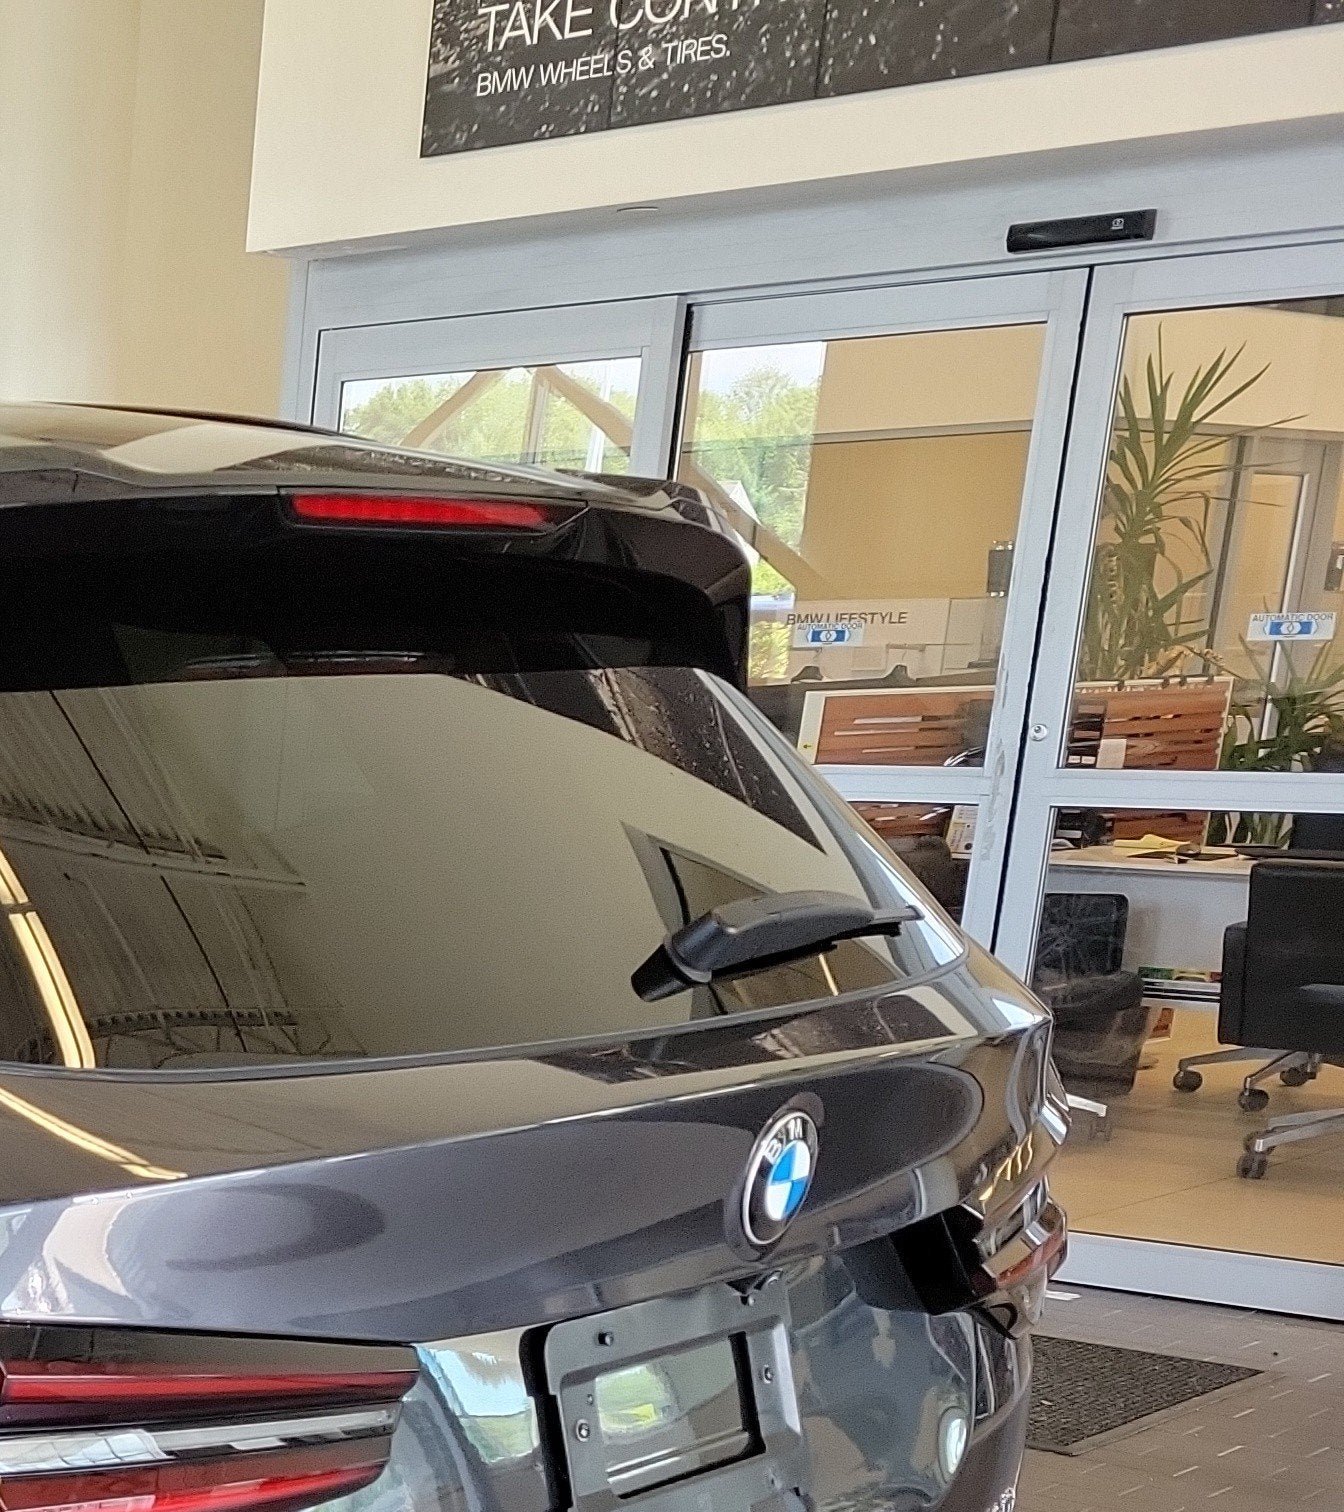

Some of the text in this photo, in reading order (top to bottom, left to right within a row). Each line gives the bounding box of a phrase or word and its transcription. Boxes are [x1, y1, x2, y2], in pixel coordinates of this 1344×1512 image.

[477, 0, 593, 53] TAKE
[476, 33, 731, 97] BMW WHEELS & TIRES.
[787, 613, 824, 625] BMW
